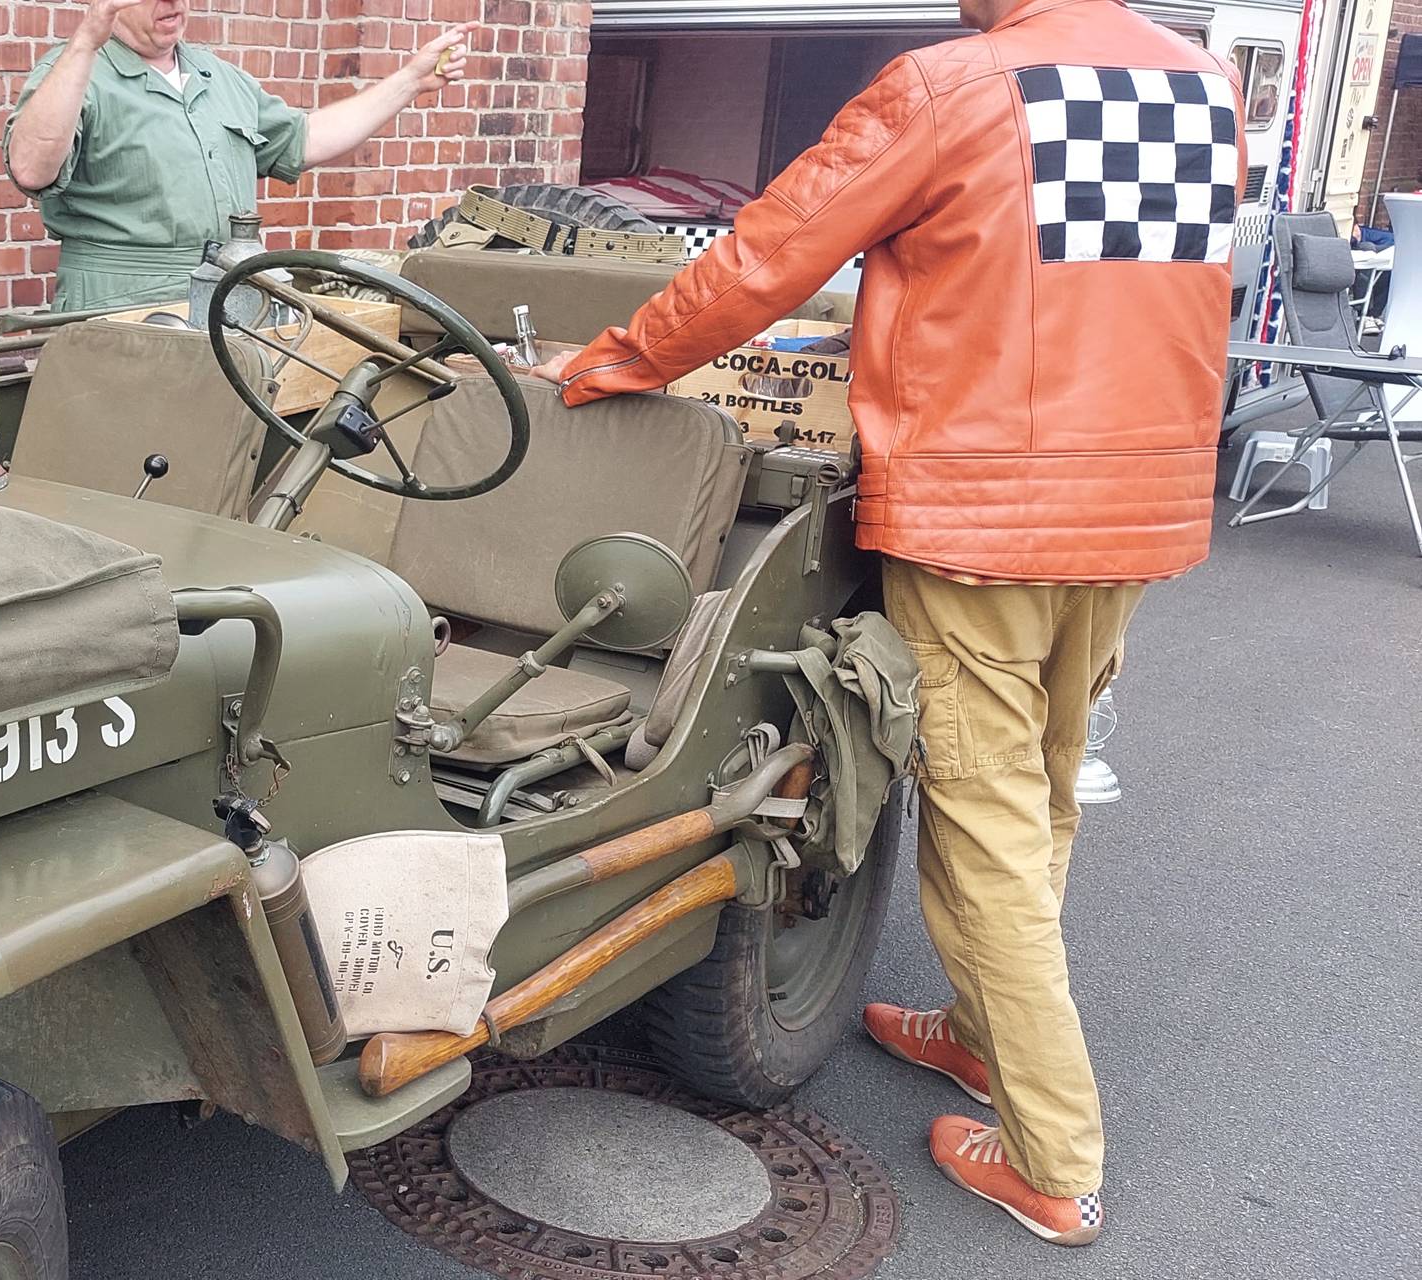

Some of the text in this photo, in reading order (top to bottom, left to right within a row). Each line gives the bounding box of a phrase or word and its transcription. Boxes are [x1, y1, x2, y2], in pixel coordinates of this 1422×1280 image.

[712, 353, 853, 383] COCA-COL
[701, 392, 803, 415] 24 BOTTLES
[373, 907, 384, 937] FORD
[367, 941, 382, 974] MOTOR
[426, 927, 455, 980] U.S.
